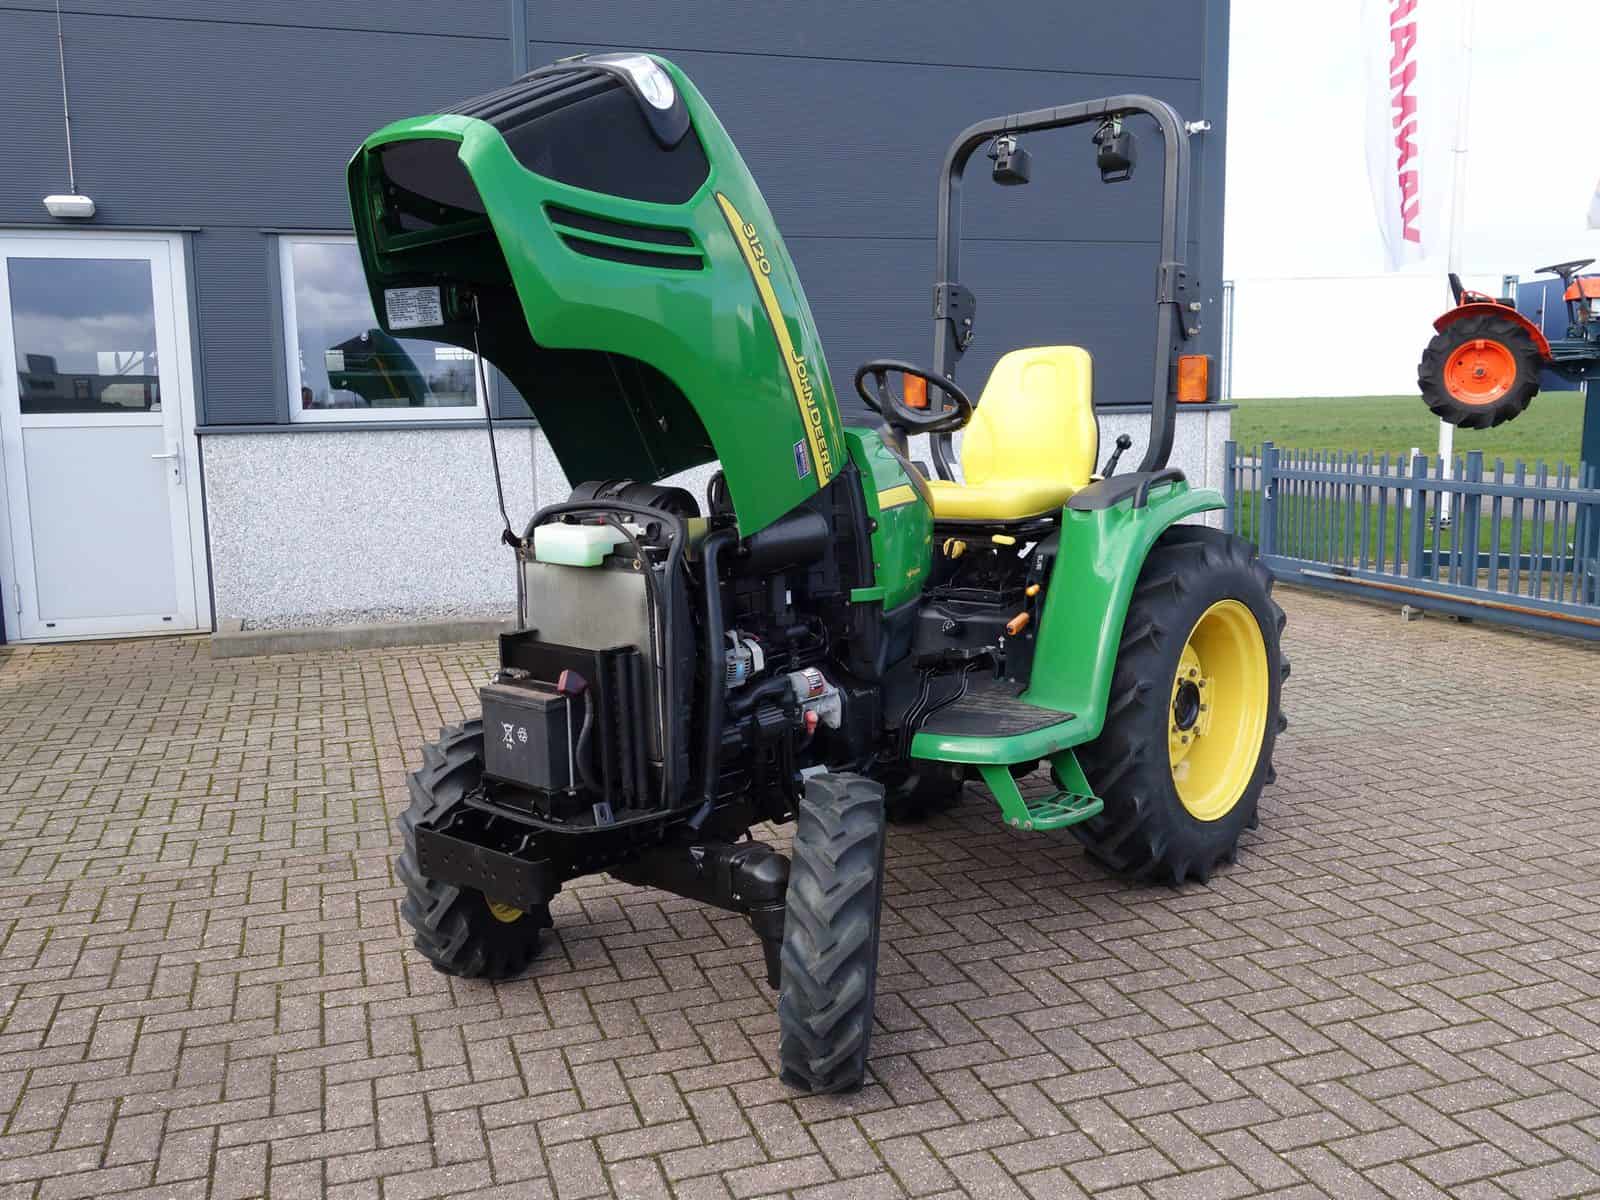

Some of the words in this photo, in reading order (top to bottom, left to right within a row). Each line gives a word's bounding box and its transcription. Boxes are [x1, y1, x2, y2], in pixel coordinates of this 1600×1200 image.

[743, 223, 771, 275] 3120
[791, 349, 815, 409] JOHN
[810, 407, 833, 479] DEERE
